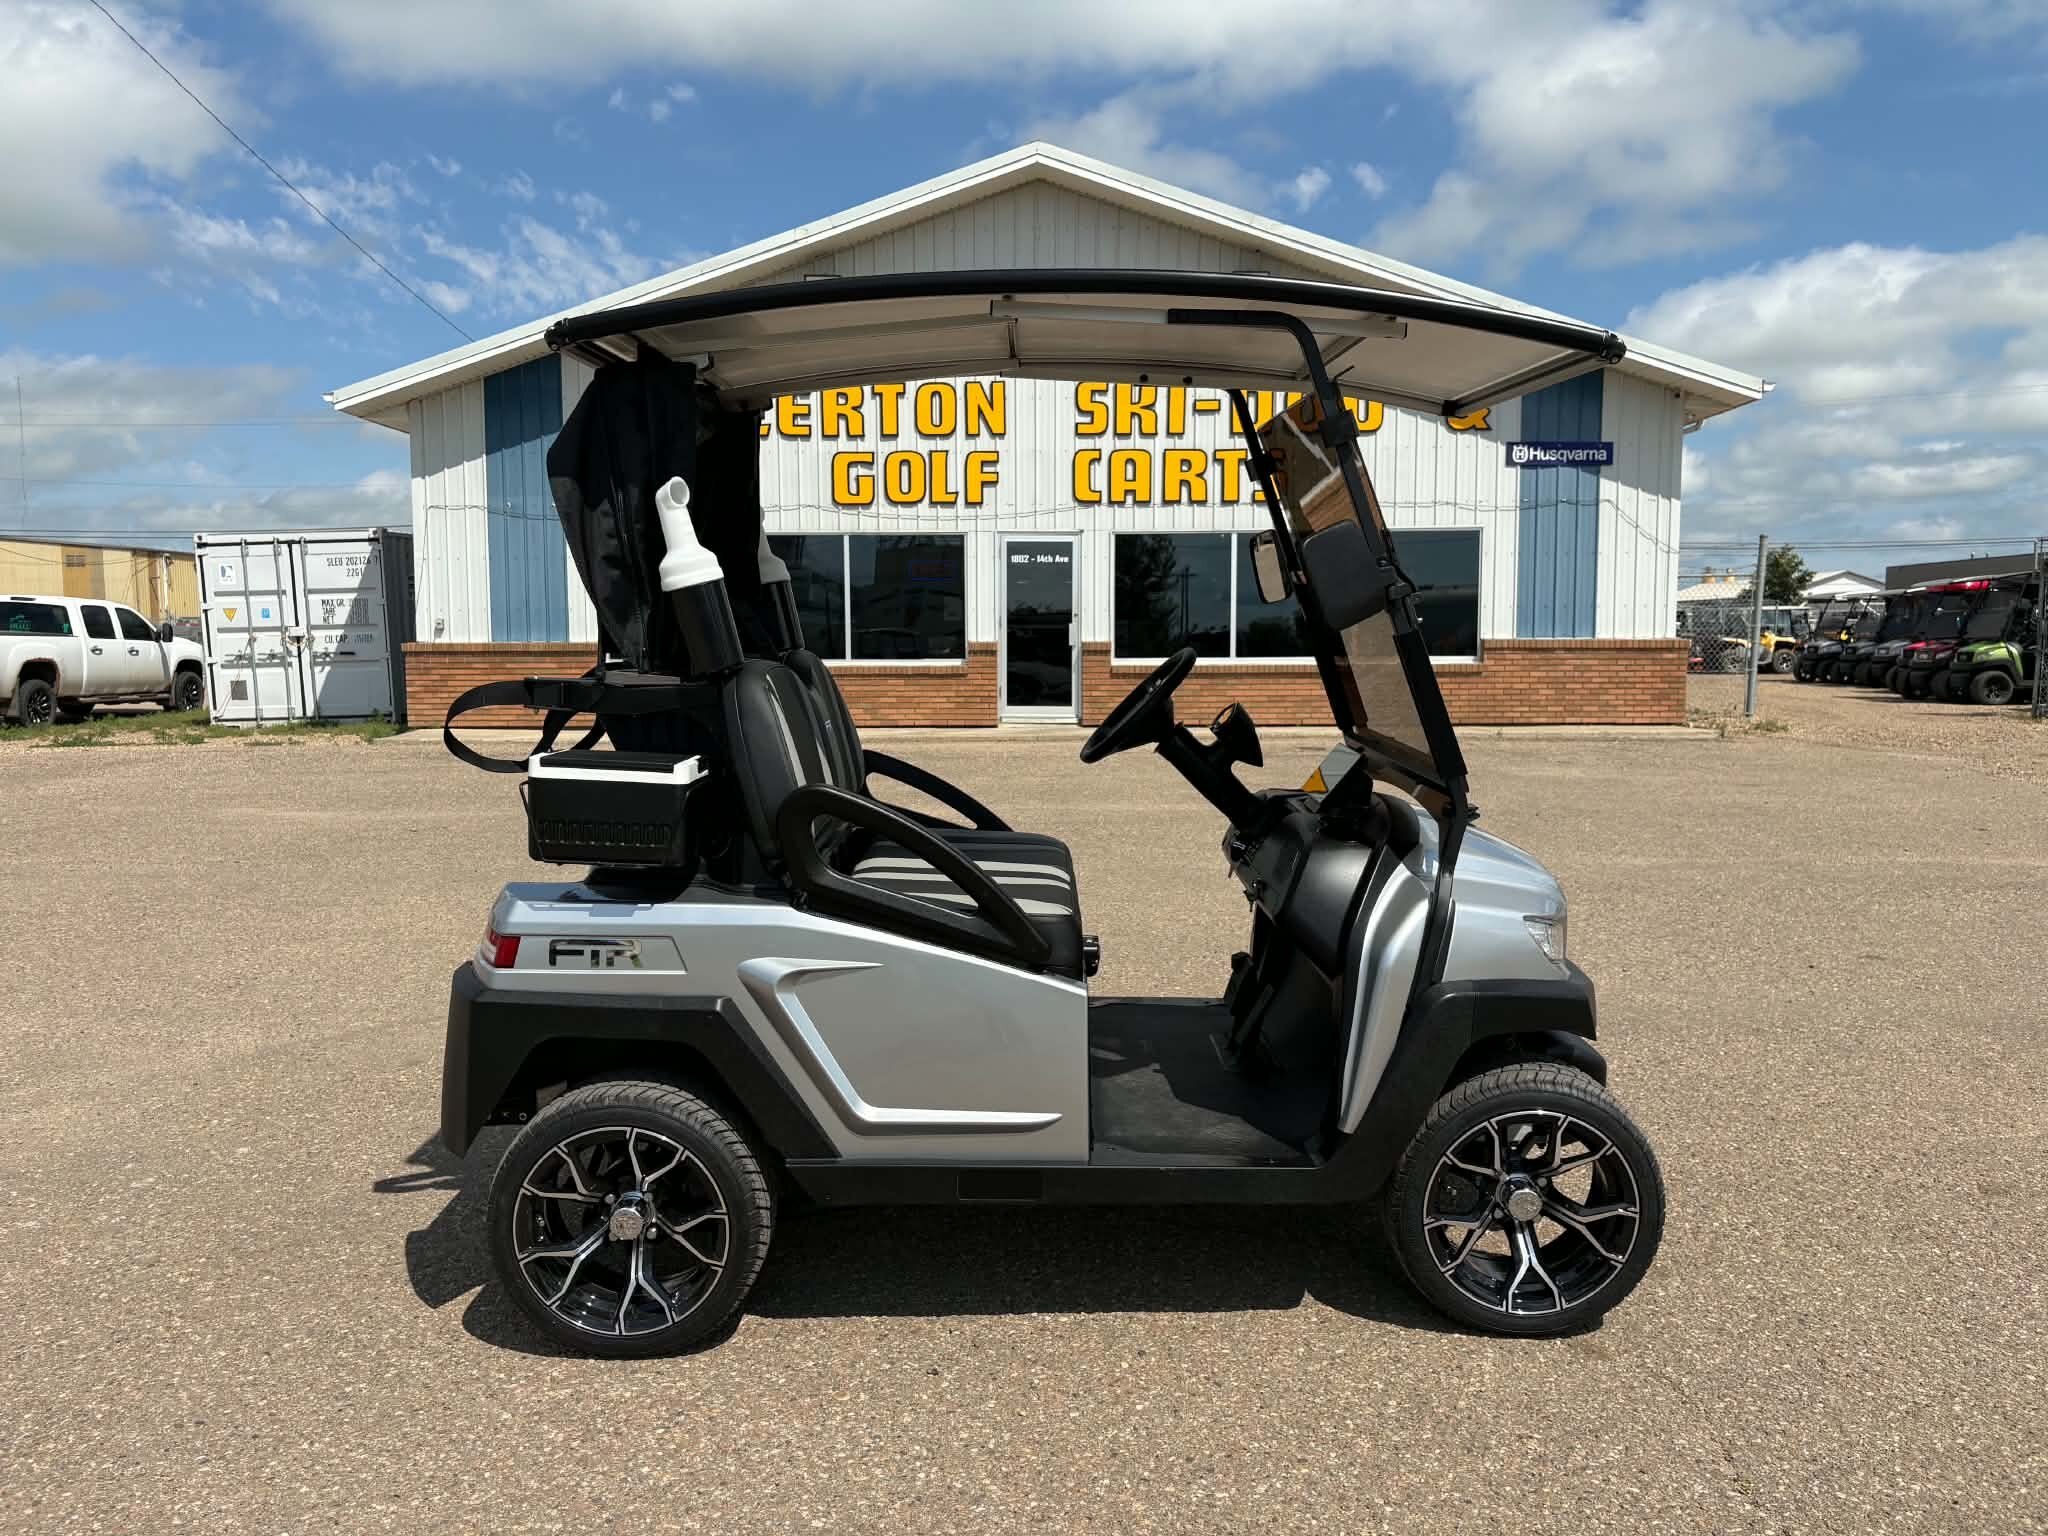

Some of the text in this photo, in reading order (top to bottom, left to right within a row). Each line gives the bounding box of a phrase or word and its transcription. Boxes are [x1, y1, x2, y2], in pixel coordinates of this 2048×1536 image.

[760, 381, 1006, 437] ERTON
[832, 450, 1000, 505] GOLF
[1529, 446, 1608, 463] Husqvarna
